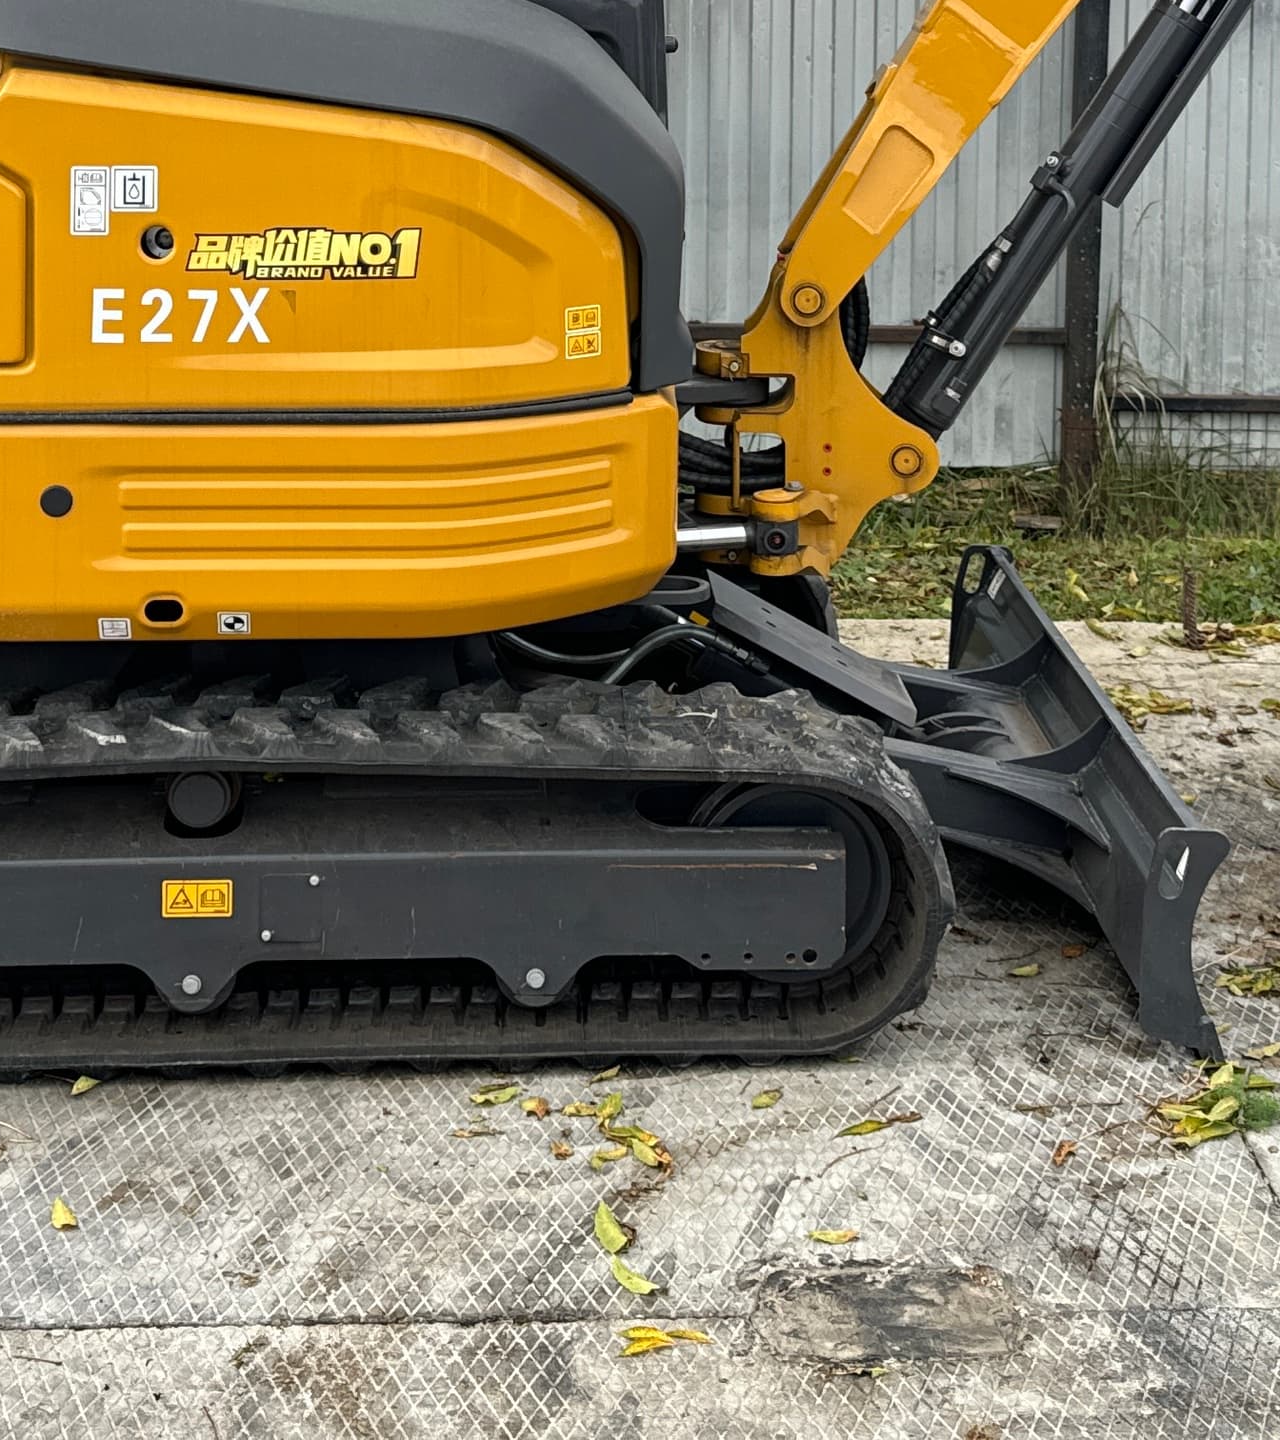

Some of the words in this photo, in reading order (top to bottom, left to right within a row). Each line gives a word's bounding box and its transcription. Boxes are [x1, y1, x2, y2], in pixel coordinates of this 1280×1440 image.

[255, 266, 323, 278] BRAND
[332, 266, 394, 278] VALUE
[90, 287, 271, 344] E27X
